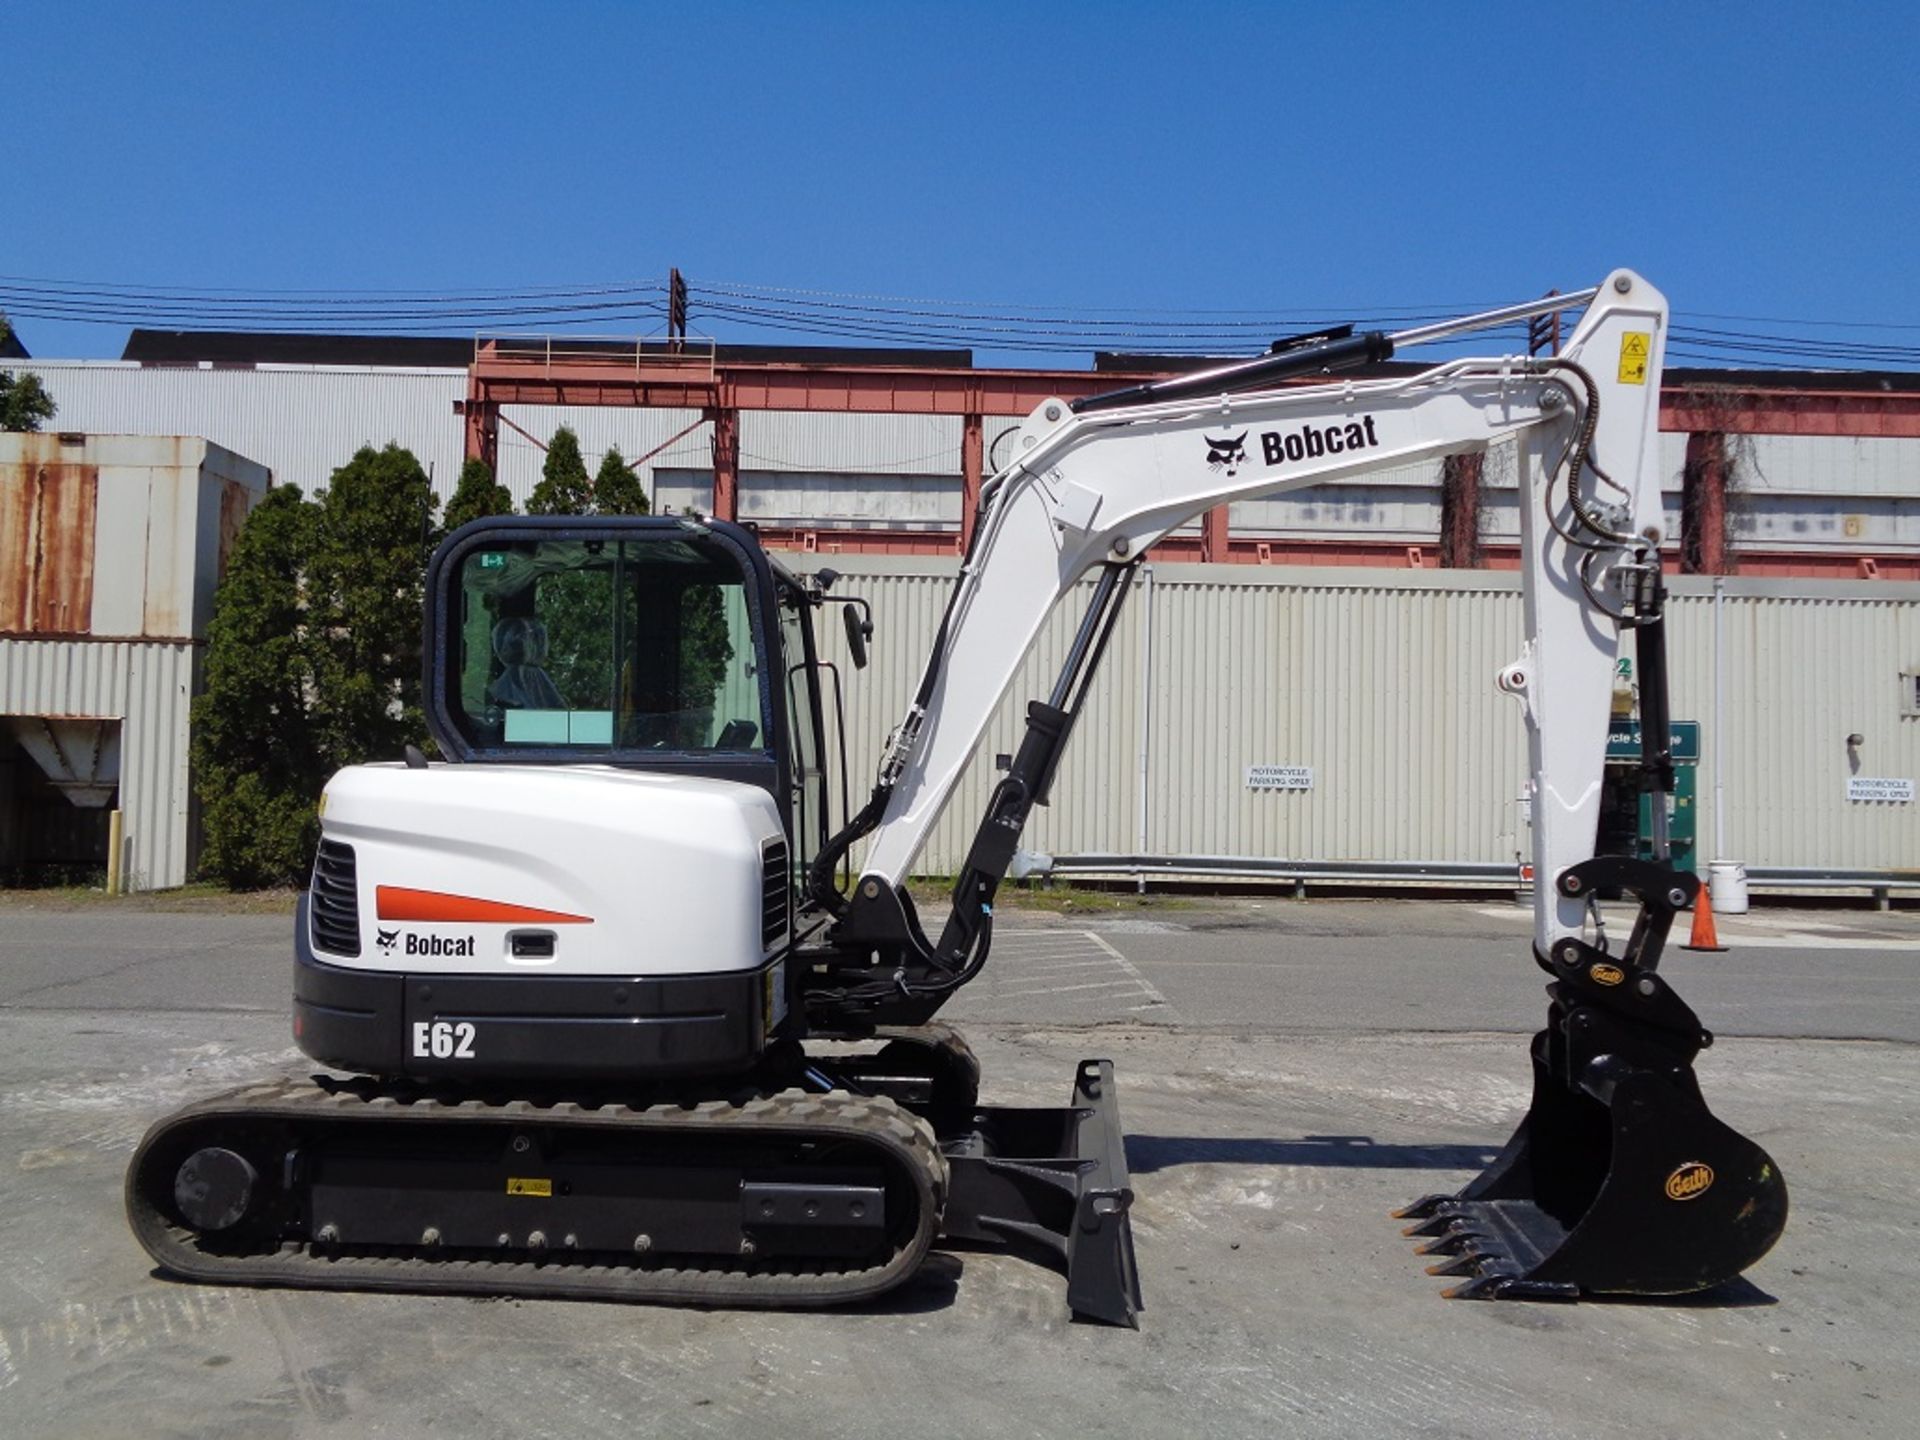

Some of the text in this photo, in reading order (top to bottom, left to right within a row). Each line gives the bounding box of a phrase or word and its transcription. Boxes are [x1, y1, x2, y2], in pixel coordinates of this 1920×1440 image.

[1261, 415, 1378, 466] Bobcat
[1250, 767, 1308, 776] MOTORCYCLE
[405, 933, 475, 957] Bobcat
[412, 1021, 477, 1059] E62
